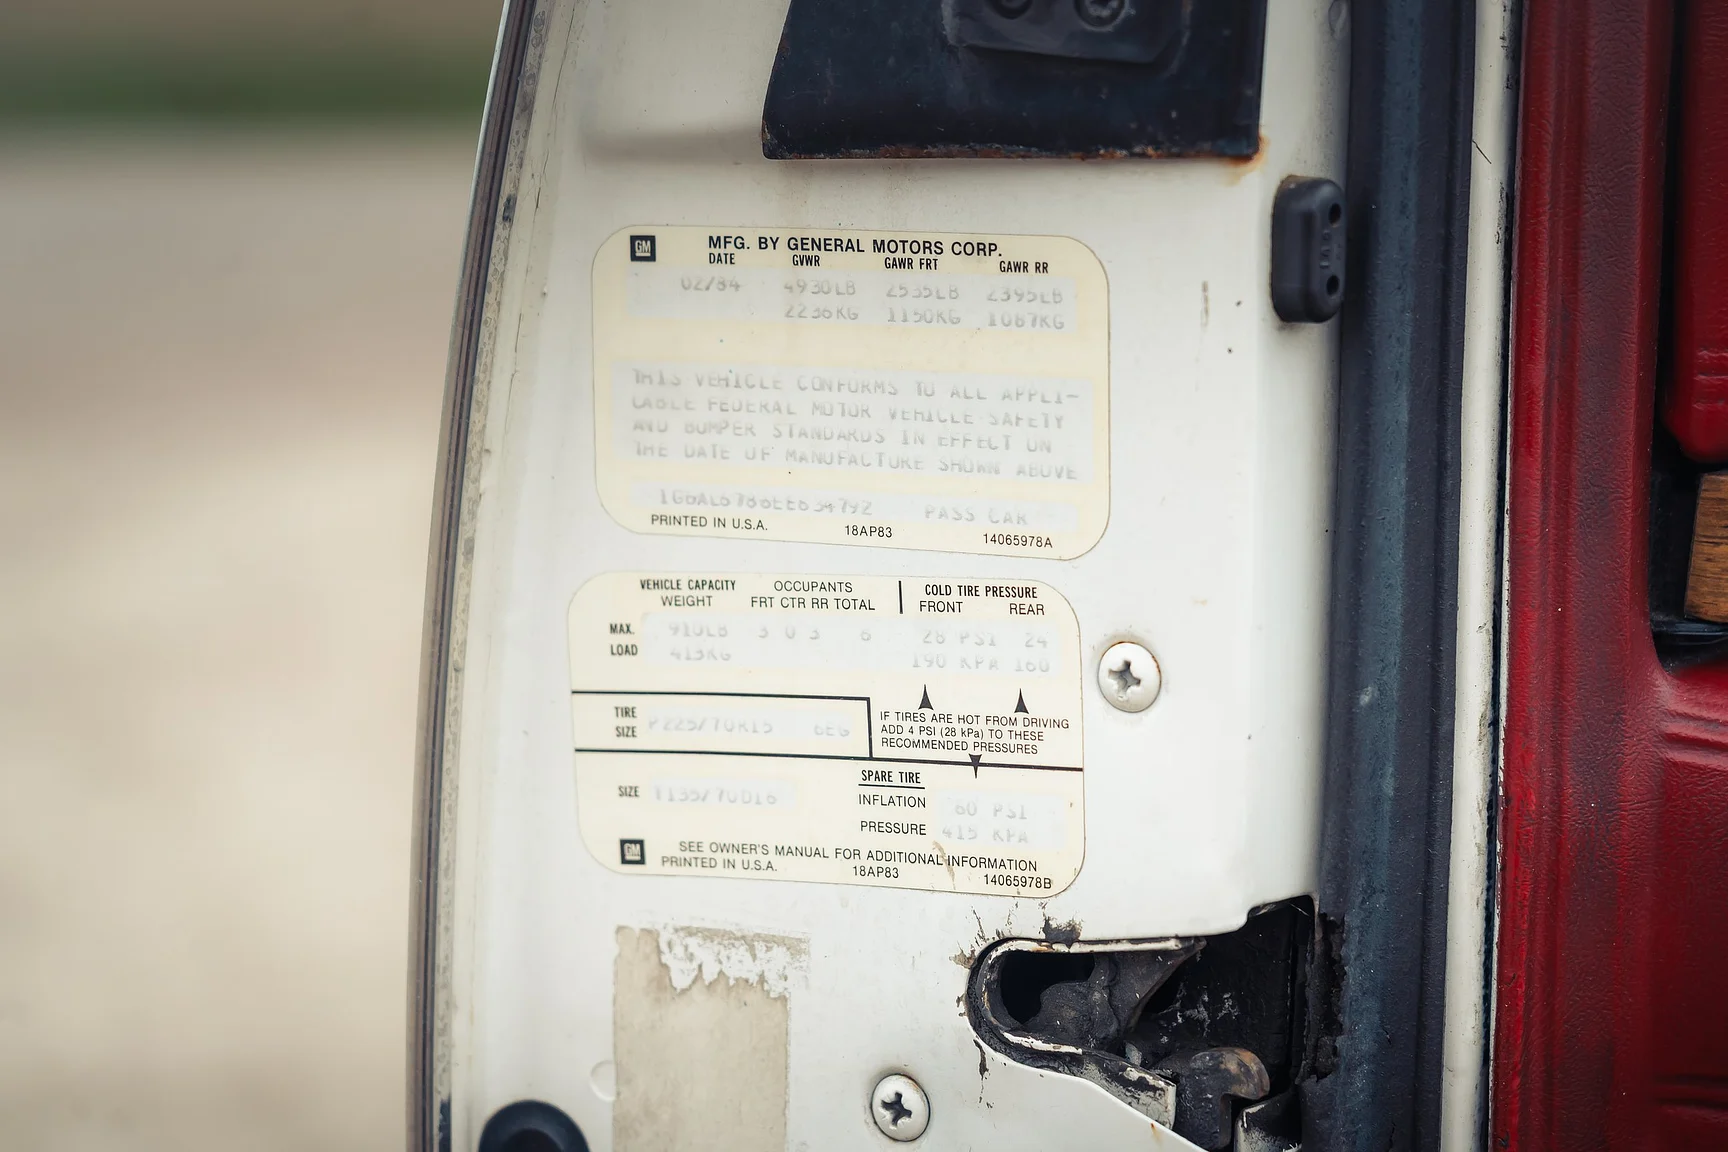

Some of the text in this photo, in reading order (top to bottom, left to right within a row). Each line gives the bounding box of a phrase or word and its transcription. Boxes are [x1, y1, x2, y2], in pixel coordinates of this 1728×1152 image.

[708, 236, 1002, 257] MFG. BY GENERAL MOTORS CORP.
[709, 253, 736, 265] DATE
[792, 255, 820, 267] GVWR
[884, 257, 938, 270] GAWR FRT
[999, 261, 1049, 274] GAWR RR
[696, 371, 783, 390] VEHICLE
[949, 385, 988, 400] ALL
[651, 514, 768, 531] PRINTED IN U.S.A.
[845, 525, 893, 538] 18AP83
[983, 533, 1053, 548] 14065978A
[640, 579, 736, 591] VEHICLE CAPACITY
[774, 581, 853, 592] OCCUPANTS
[925, 584, 1038, 598] COLD TIRE PRESSURE
[661, 595, 713, 606] WEIGHT
[751, 597, 876, 611] FRT CTR RR TOTAL
[920, 601, 963, 613] FRONT
[1009, 603, 1045, 616] REAR
[609, 623, 635, 635] MAX.
[610, 644, 638, 656] LOAD
[615, 707, 637, 718] TIRE
[880, 711, 1070, 729] IF TIRES ARE HOT FROM DRIVING
[615, 726, 637, 738] SIZE
[881, 725, 1044, 741] ADD 4 PSI (28 kPa) TO THESE
[881, 738, 1038, 754] RECOMMENDED PRESSURES
[861, 770, 921, 783] SPARE TIRE
[618, 786, 639, 798] SIZE
[858, 794, 926, 808] INFLATION
[861, 821, 927, 835] PRESSURE
[679, 841, 1038, 872] SEE OWNER'S MANUAL FOR ADDITIONAL INFORMATION
[661, 856, 777, 871] PRINTED IN U.S.A.
[852, 866, 899, 878] 18AP83
[984, 875, 1052, 889] 14065978B
